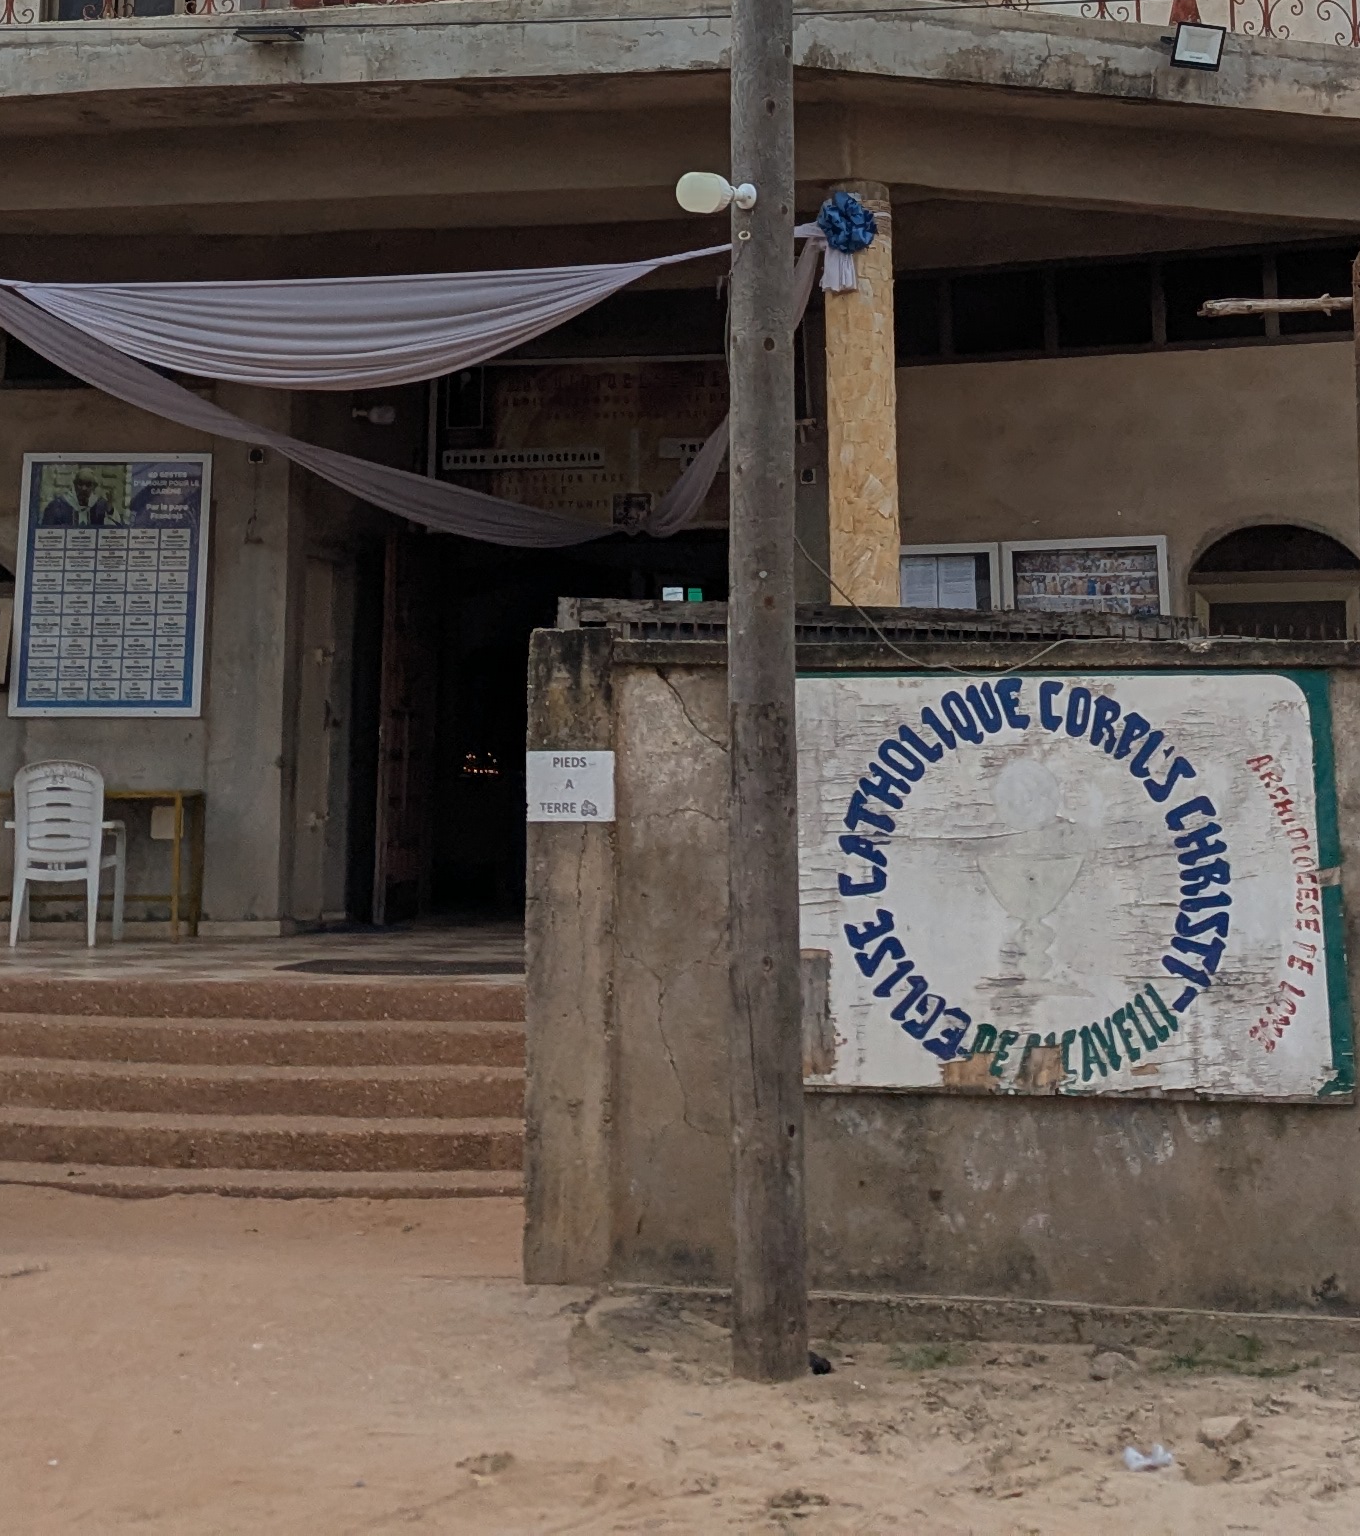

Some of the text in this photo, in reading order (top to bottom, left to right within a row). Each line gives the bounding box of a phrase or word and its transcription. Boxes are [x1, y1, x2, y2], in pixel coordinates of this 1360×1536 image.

[552, 756, 587, 768] PIEDS
[564, 778, 575, 790] A
[837, 677, 1031, 897] CATHOLIQUE
[540, 801, 577, 814] TERRE
[842, 908, 972, 1061] EGLISE
